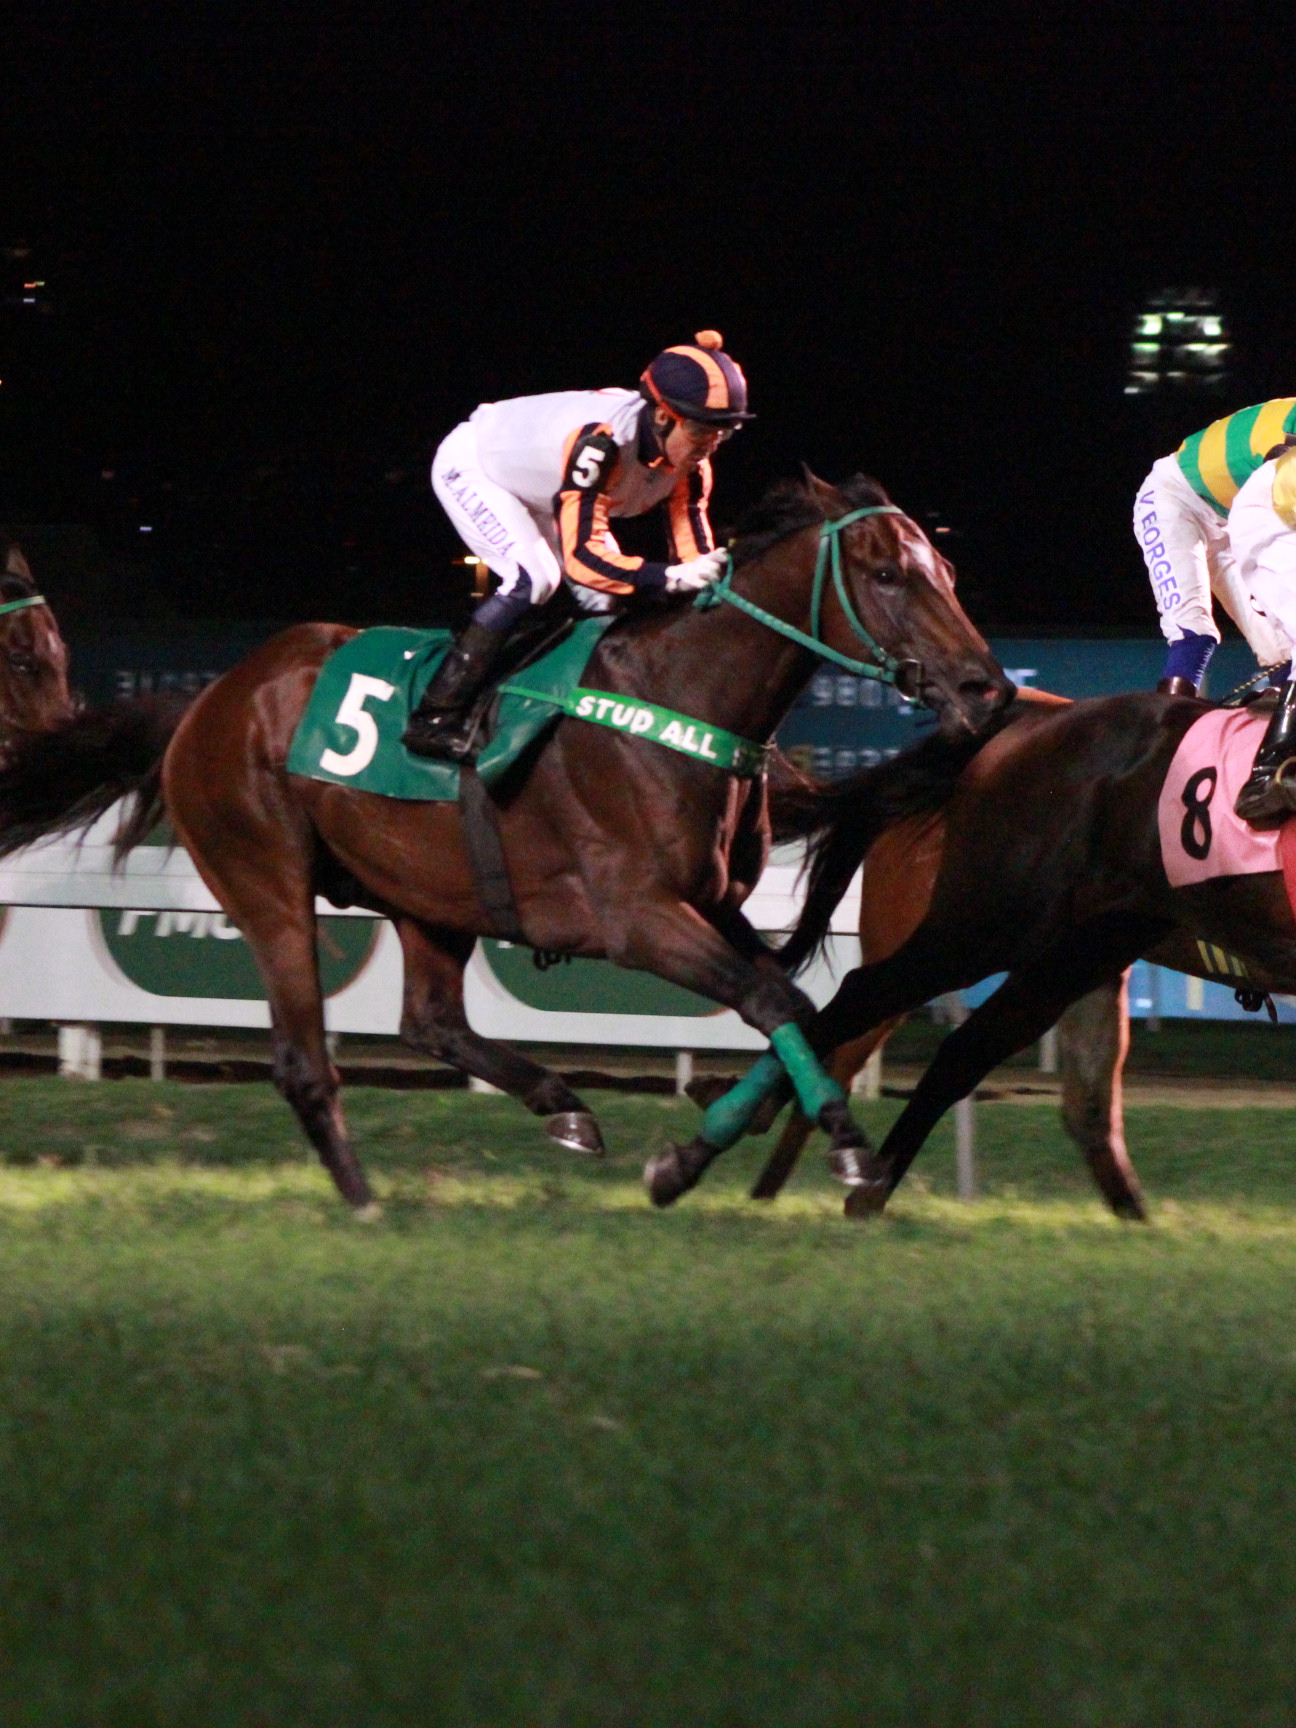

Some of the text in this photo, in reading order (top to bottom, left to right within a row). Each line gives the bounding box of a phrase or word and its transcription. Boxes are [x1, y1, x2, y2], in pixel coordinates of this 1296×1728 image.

[572, 446, 606, 488] 5
[319, 672, 395, 777] 5
[574, 695, 718, 760] STUD ALL
[1180, 765, 1218, 860] 8
